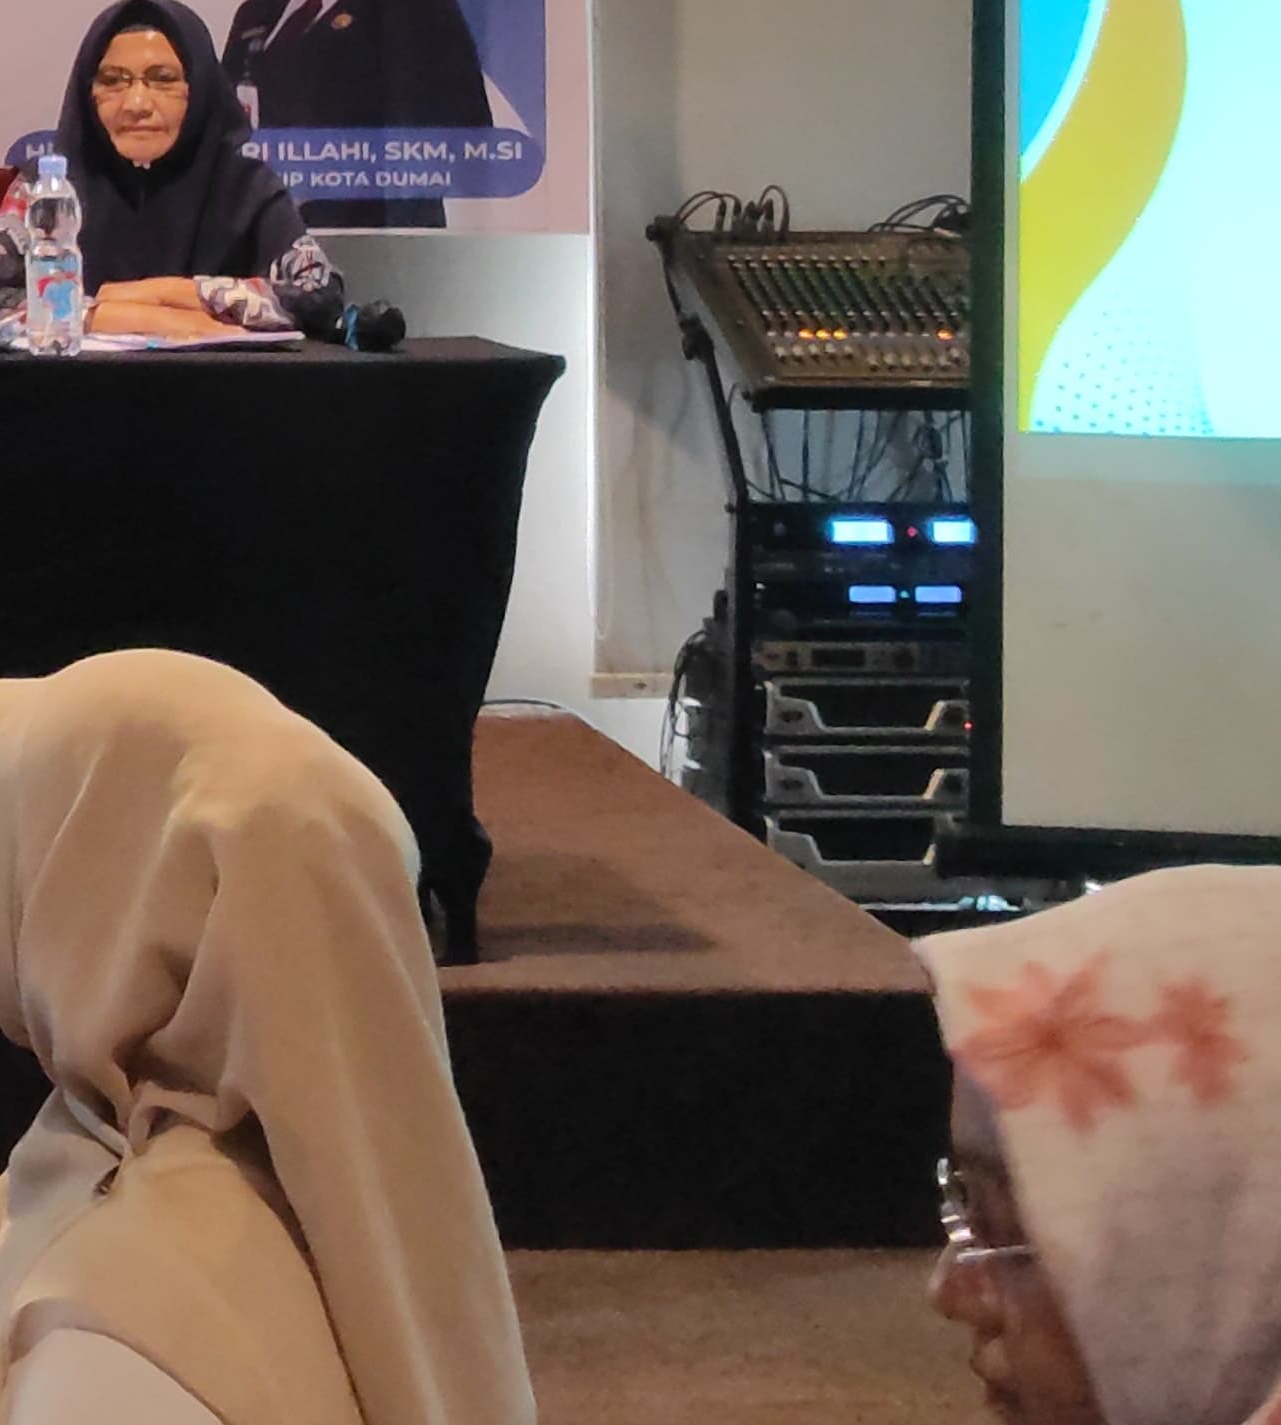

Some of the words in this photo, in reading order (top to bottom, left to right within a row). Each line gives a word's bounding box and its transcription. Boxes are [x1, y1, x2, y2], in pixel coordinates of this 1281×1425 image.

[277, 141, 377, 164] ILLAHI,
[384, 139, 457, 164] SKM,
[464, 140, 523, 160] M.SI
[310, 171, 370, 187] KOTA
[375, 170, 452, 187] DUMAI
